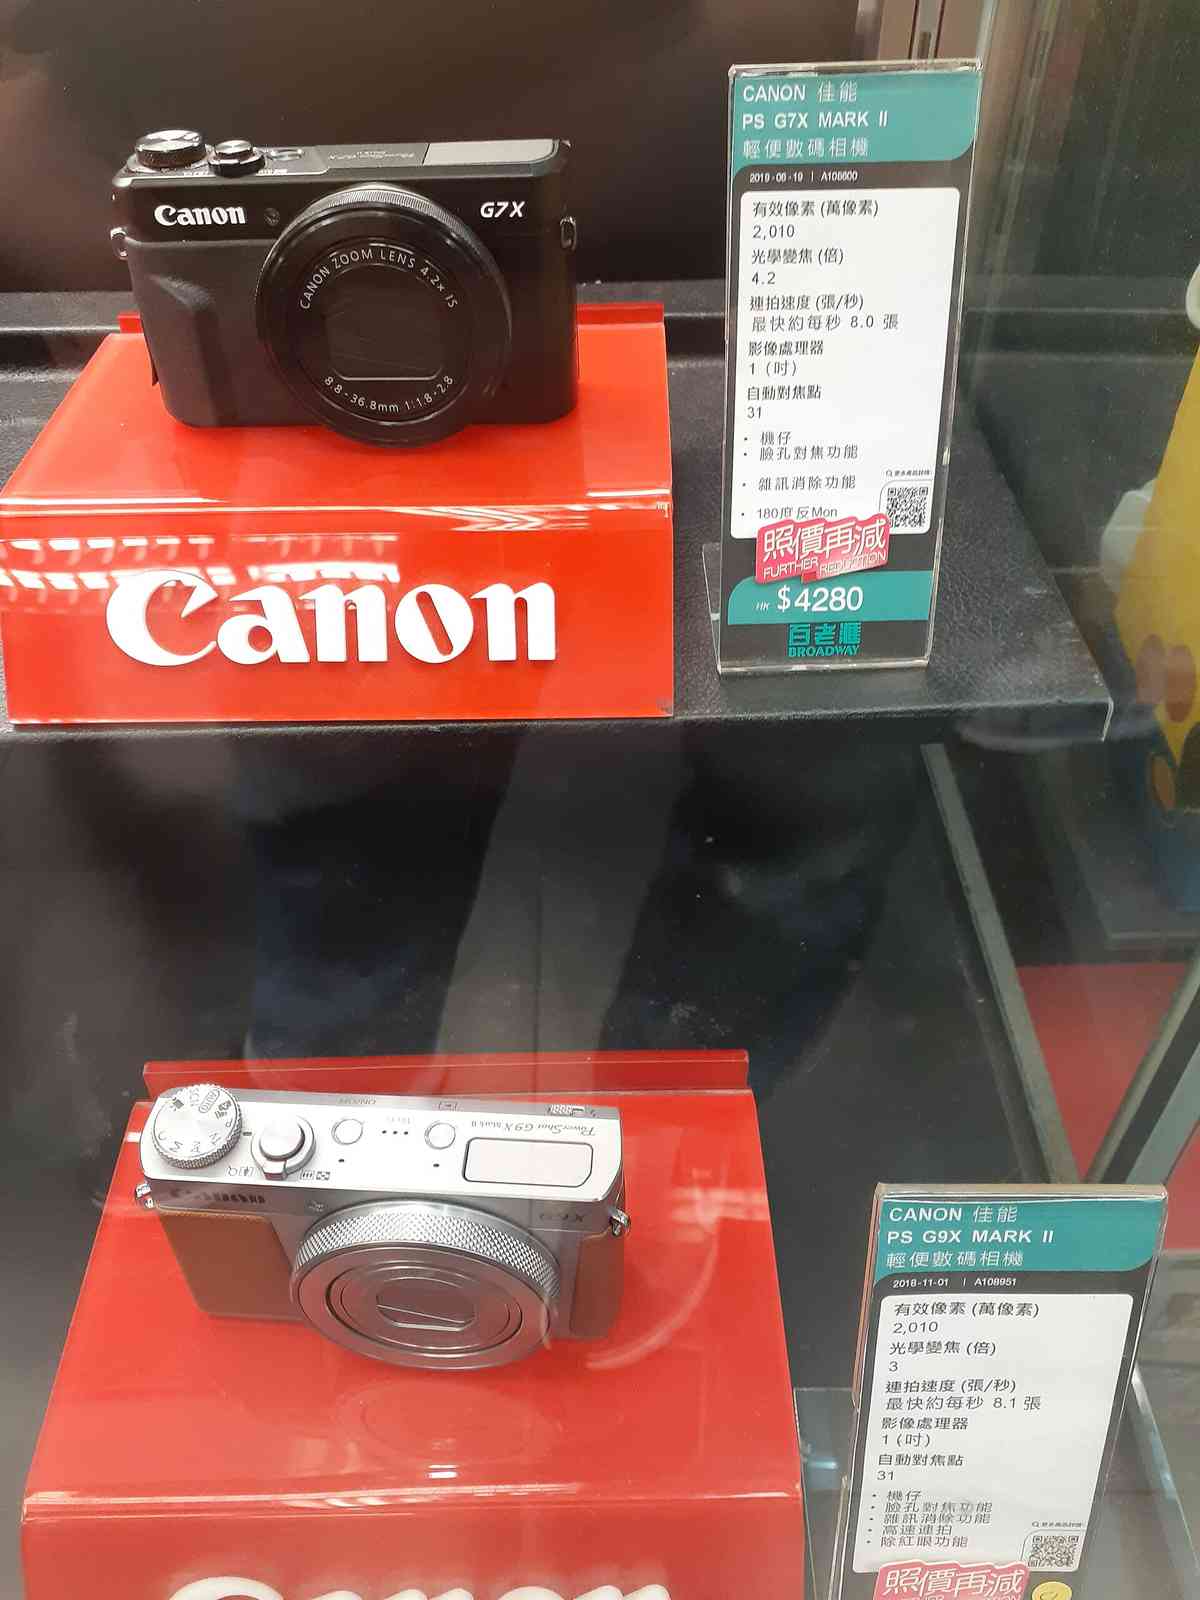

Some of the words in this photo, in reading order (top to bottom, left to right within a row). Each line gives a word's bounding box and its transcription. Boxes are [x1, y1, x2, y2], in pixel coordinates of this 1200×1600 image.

[743, 85, 806, 103] CANON
[816, 79, 857, 103] 佳能
[742, 113, 765, 130] PS
[774, 112, 808, 129] G7X
[818, 110, 869, 128] MARK
[879, 110, 889, 128] II
[743, 136, 869, 160] 輕便數碼相機
[153, 205, 246, 226] Canon
[753, 200, 815, 217] 有效像素
[820, 199, 879, 218] (萬像素)
[753, 224, 795, 240] 2,010
[752, 248, 812, 265] 光學變焦
[818, 247, 844, 266] (倍)
[300, 266, 331, 310] CANON
[331, 249, 374, 269] ZOOM
[380, 250, 416, 268] LENS
[445, 294, 458, 308] IS
[752, 271, 776, 286] 4.2
[750, 295, 811, 312] 連拍速度
[816, 293, 864, 312] (張/秒)
[752, 314, 841, 332] 最快約每秒
[850, 315, 874, 328] 8.0
[883, 313, 899, 330] 張
[748, 340, 824, 356] 影像處理器
[747, 384, 822, 401] 自動對焦點
[747, 406, 762, 419] 31
[760, 431, 791, 446] 機仔
[759, 444, 858, 461] 臉孔對焦功能
[758, 475, 856, 491] 雜訊消除功能
[763, 519, 887, 562] 照價再減
[763, 556, 819, 579] FURTHER
[777, 585, 864, 613] $4280
[106, 570, 556, 667] Canon
[789, 622, 862, 646] 百老匯
[788, 646, 859, 657] BROADWAY
[889, 1207, 962, 1222] CANON
[973, 1206, 1018, 1223] 佳能
[887, 1231, 913, 1244] PS
[922, 1230, 962, 1243] G9X
[972, 1230, 1032, 1243] MARK
[1043, 1230, 1054, 1243] II
[886, 1250, 1023, 1268] 輕便數碼相機
[894, 1302, 966, 1317] 有效像素
[971, 1302, 1040, 1318] (萬像素)
[893, 1321, 938, 1335] 2,010
[889, 1341, 960, 1355] 光學變焦
[966, 1342, 997, 1356] (倍)
[888, 1361, 899, 1372] 3
[885, 1379, 956, 1393] 連拍速度
[961, 1378, 1017, 1393] (張/秒)
[885, 1396, 984, 1411] 最快約每秒
[992, 1397, 1016, 1409] 8.1
[1023, 1396, 1041, 1411] 張
[881, 1416, 969, 1430] 影像處理器
[878, 1454, 964, 1467] 自動對焦點
[876, 1470, 895, 1481] 31
[882, 1567, 1026, 1598] 照價再減
